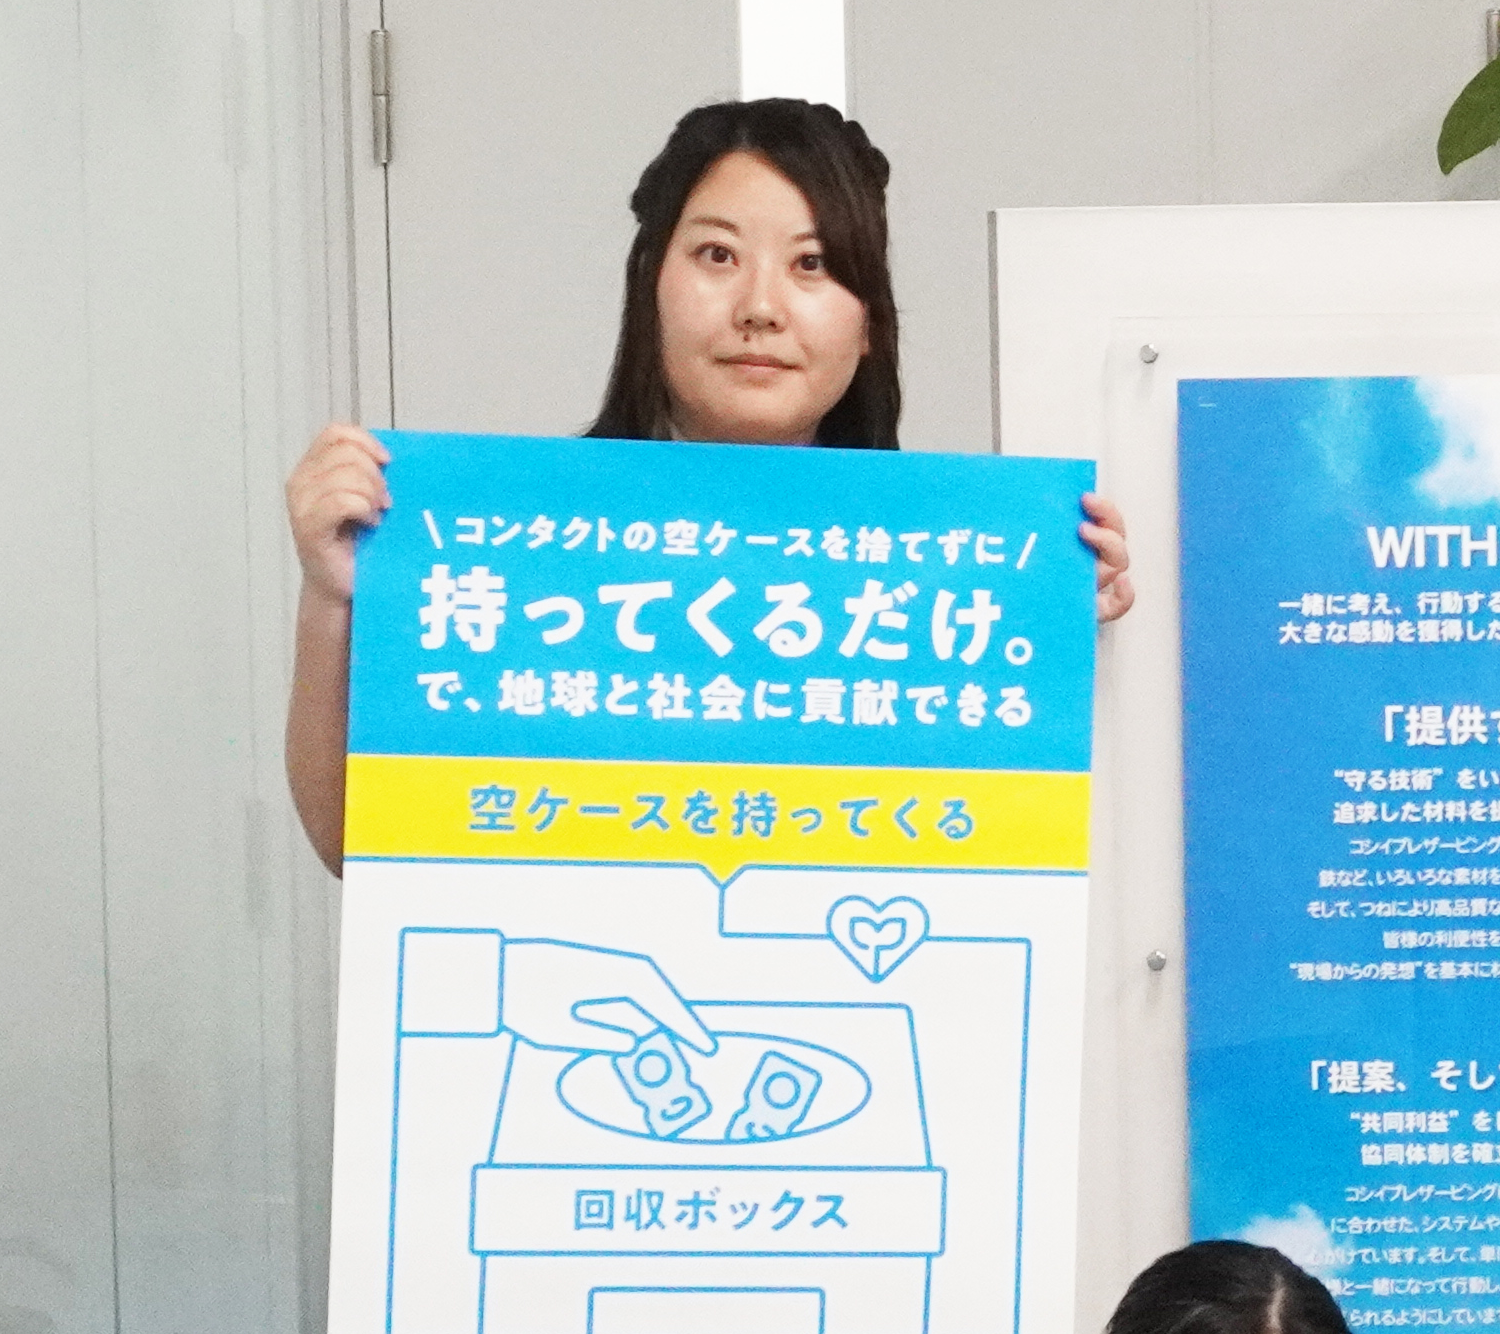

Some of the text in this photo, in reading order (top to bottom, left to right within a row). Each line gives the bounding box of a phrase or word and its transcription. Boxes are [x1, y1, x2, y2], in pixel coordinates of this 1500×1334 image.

[1366, 524, 1498, 568] WITH
[418, 564, 1034, 667] 持ってくるだけ。
[416, 670, 1034, 728] で、地球と社会に貢献できる
[469, 782, 977, 841] 空ケースを持ってくる
[573, 1187, 851, 1232] 回収ボックス
